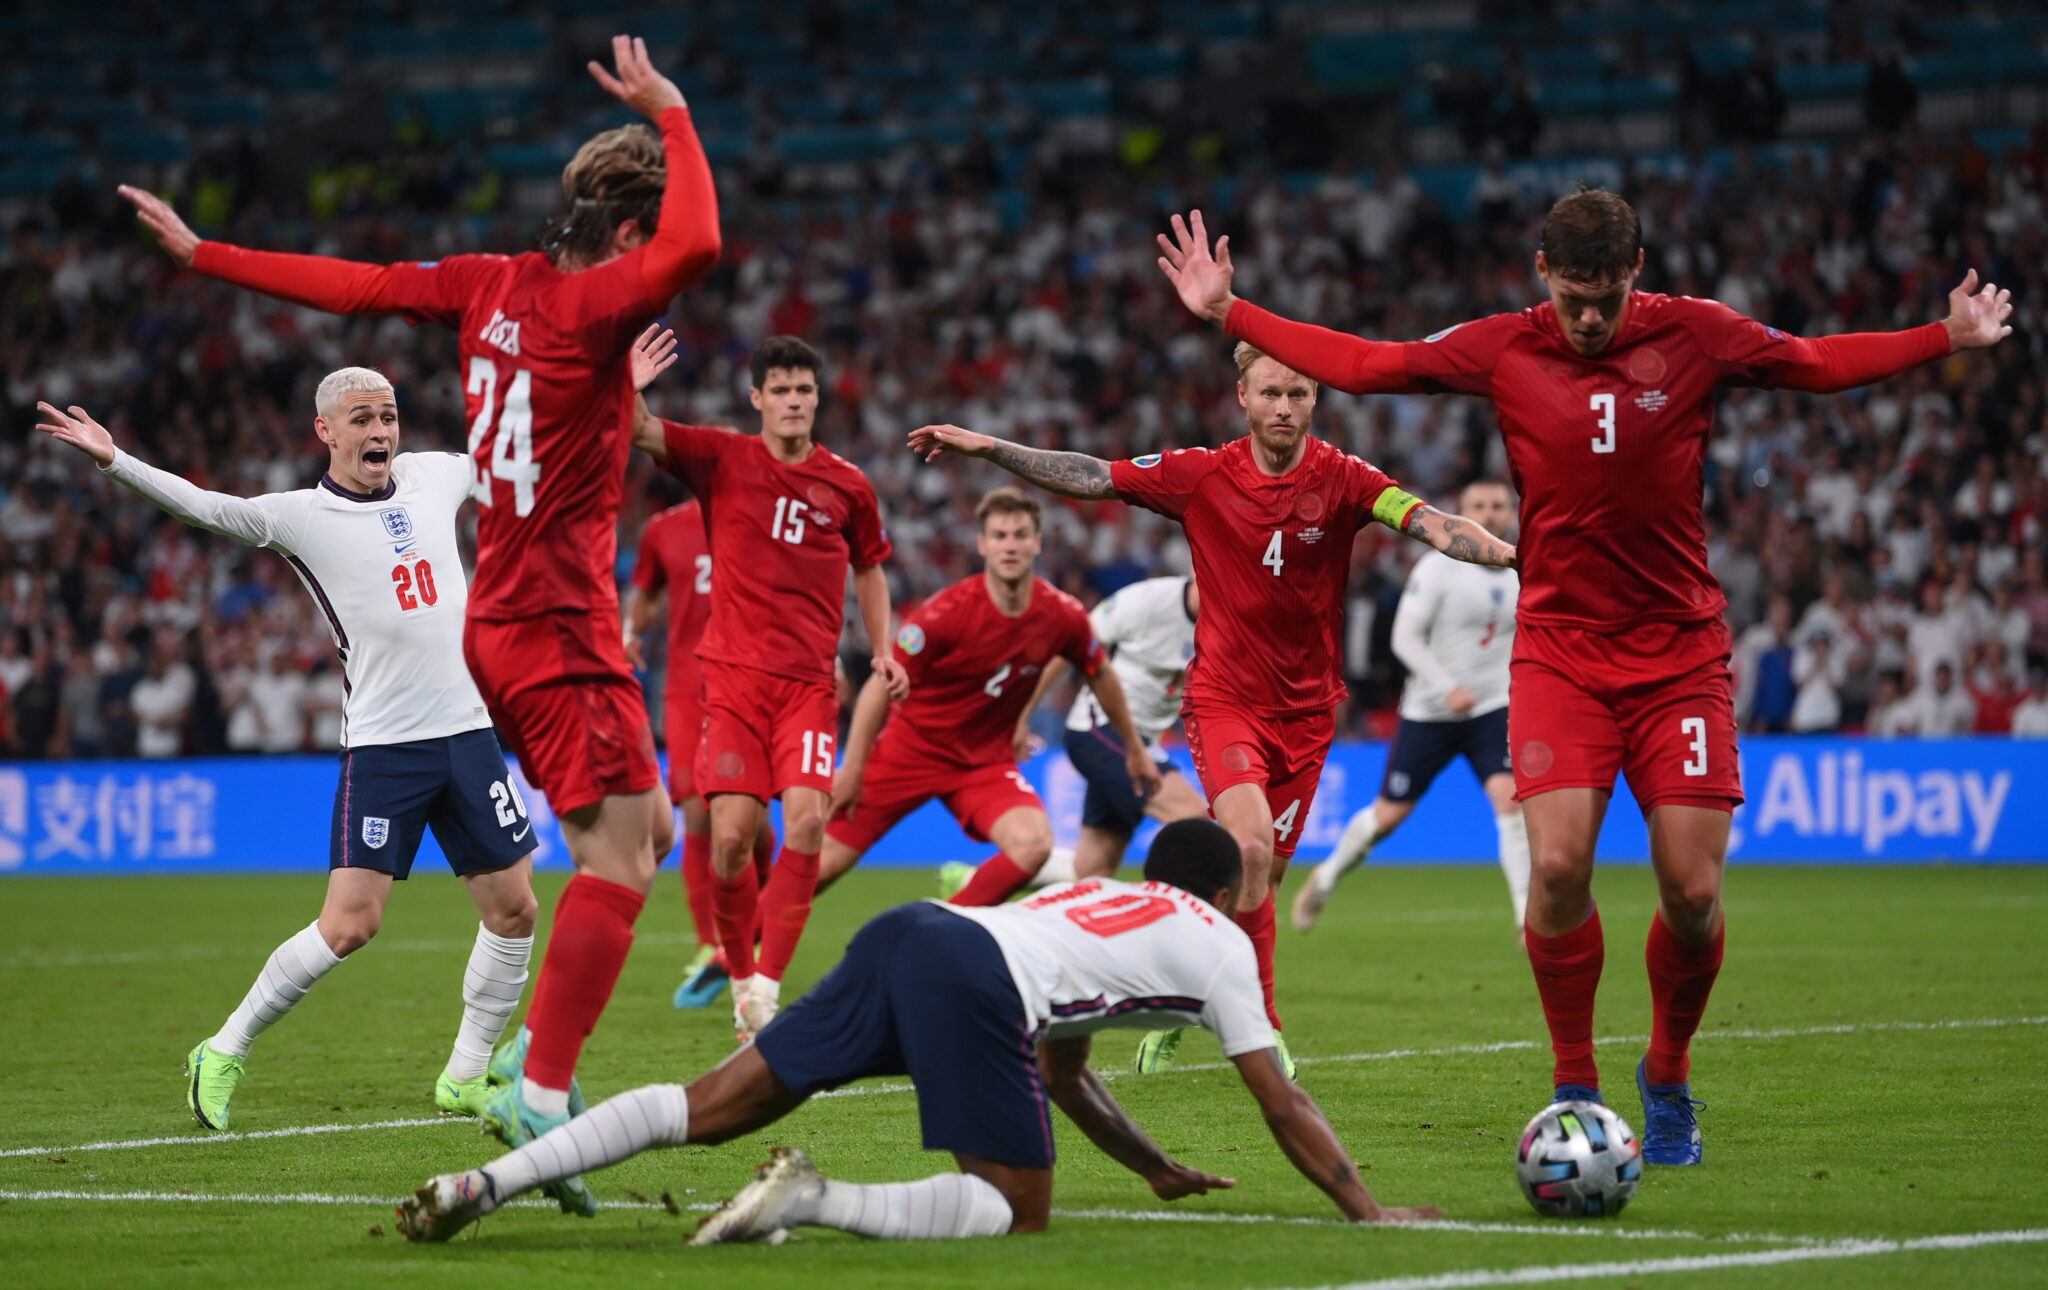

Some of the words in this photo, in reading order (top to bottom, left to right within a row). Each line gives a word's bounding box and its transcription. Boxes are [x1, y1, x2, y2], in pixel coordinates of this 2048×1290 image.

[467, 355, 541, 517] 24
[1590, 393, 1616, 454] 3
[771, 496, 809, 545] 15
[1262, 530, 1284, 577] 4
[391, 559, 438, 611] 20
[984, 663, 1012, 698] 2
[801, 730, 833, 778] 15
[1681, 717, 1708, 776] 3
[36, 773, 214, 860] 支付宝
[489, 774, 527, 828] 20
[1273, 799, 1301, 842] 4
[1757, 750, 2012, 854] Alipay
